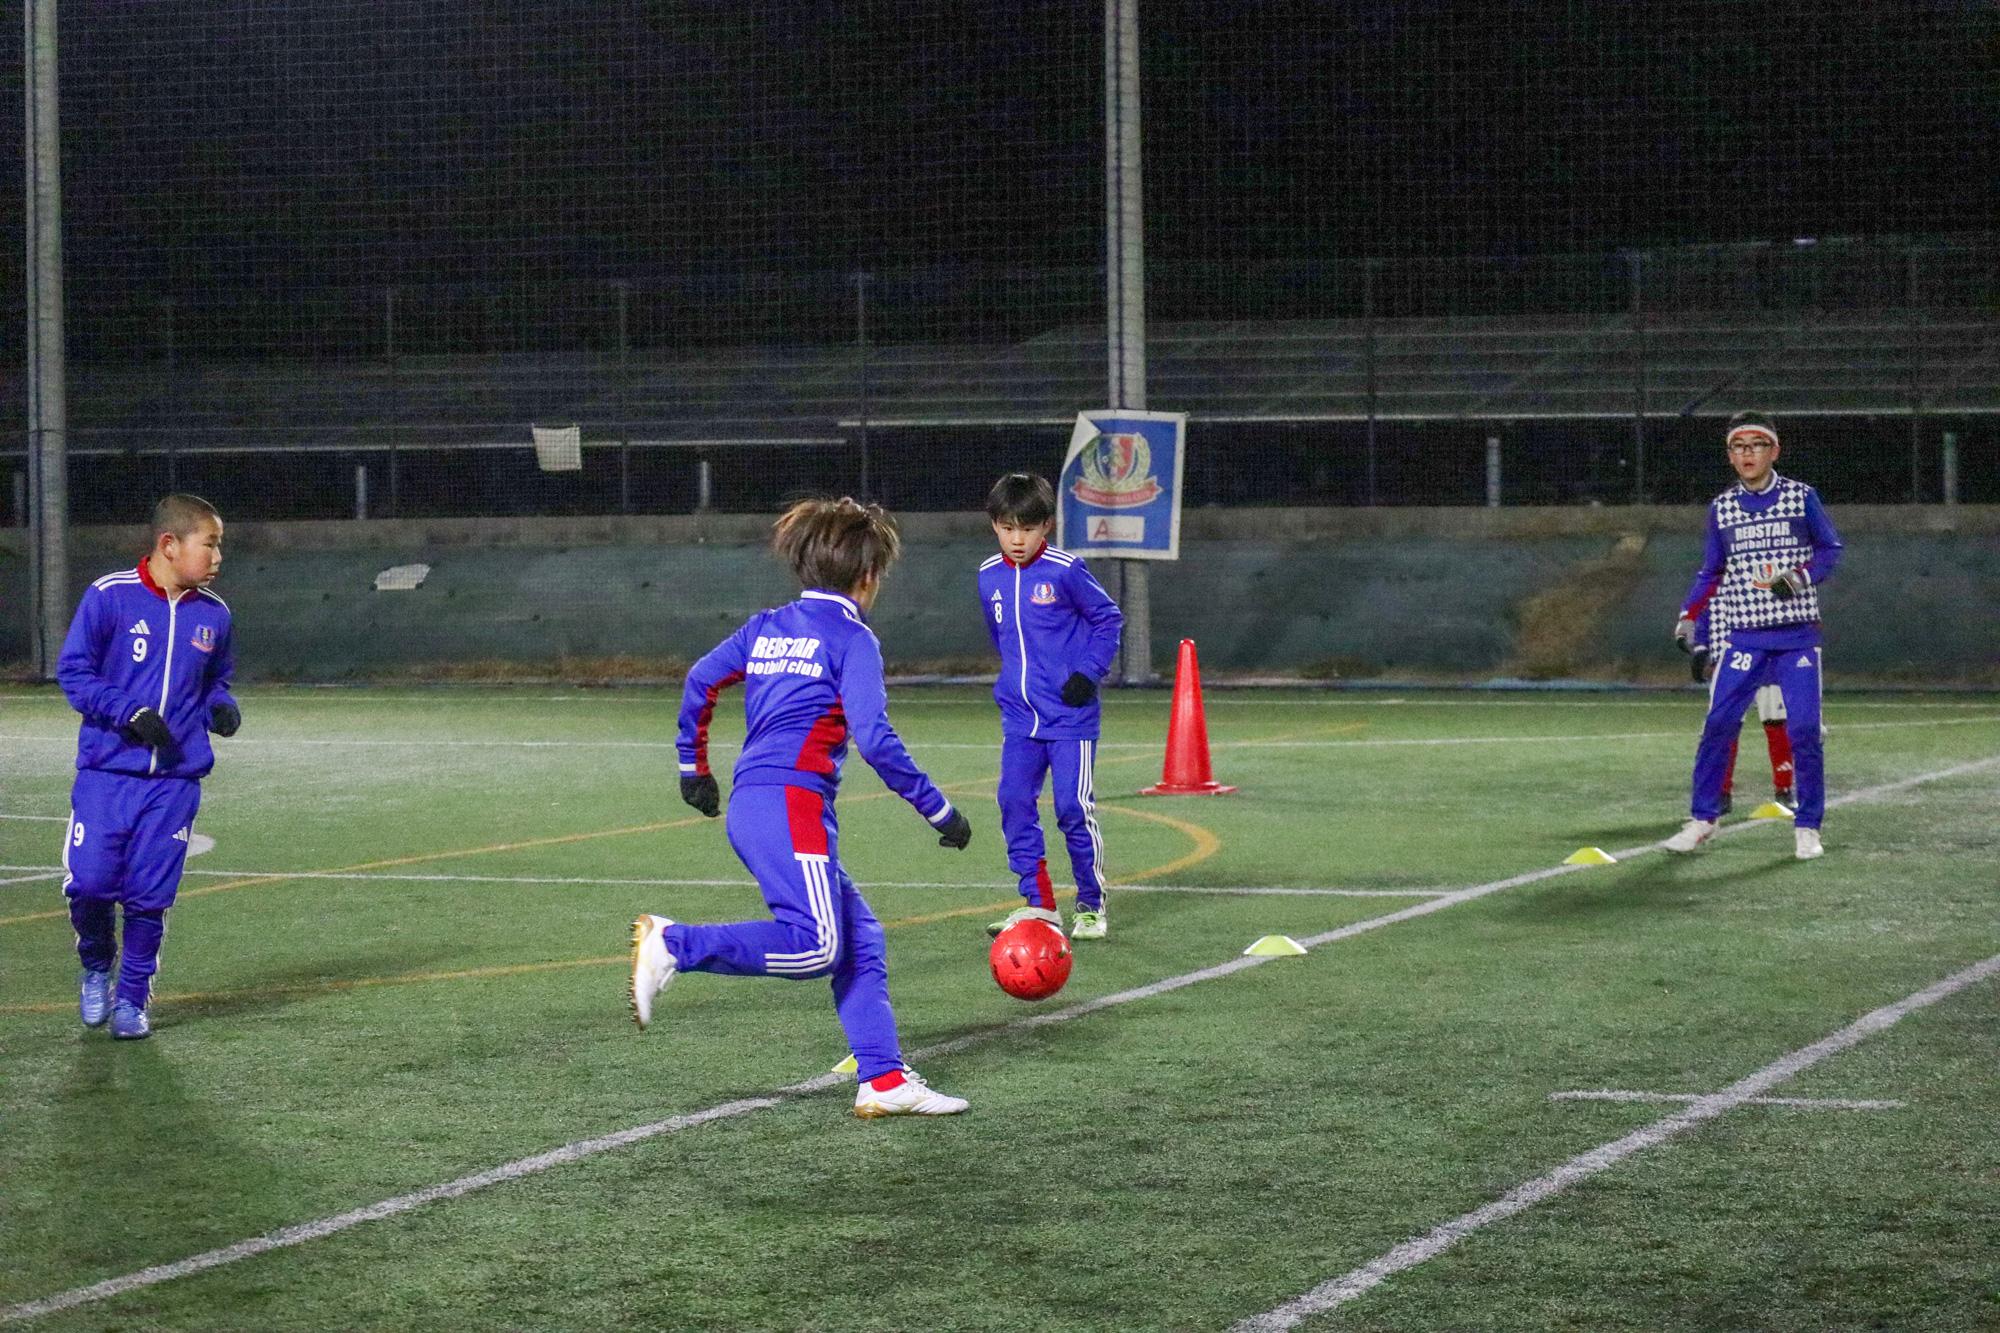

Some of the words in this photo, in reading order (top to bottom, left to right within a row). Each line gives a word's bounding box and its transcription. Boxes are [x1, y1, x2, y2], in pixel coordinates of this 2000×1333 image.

[1735, 521, 1790, 541] REDSTAR
[1773, 535, 1799, 547] club
[994, 602, 1003, 624] 8
[132, 637, 147, 662] 9
[786, 660, 823, 678] club
[1730, 651, 1753, 671] 28
[73, 822, 85, 847] 9
